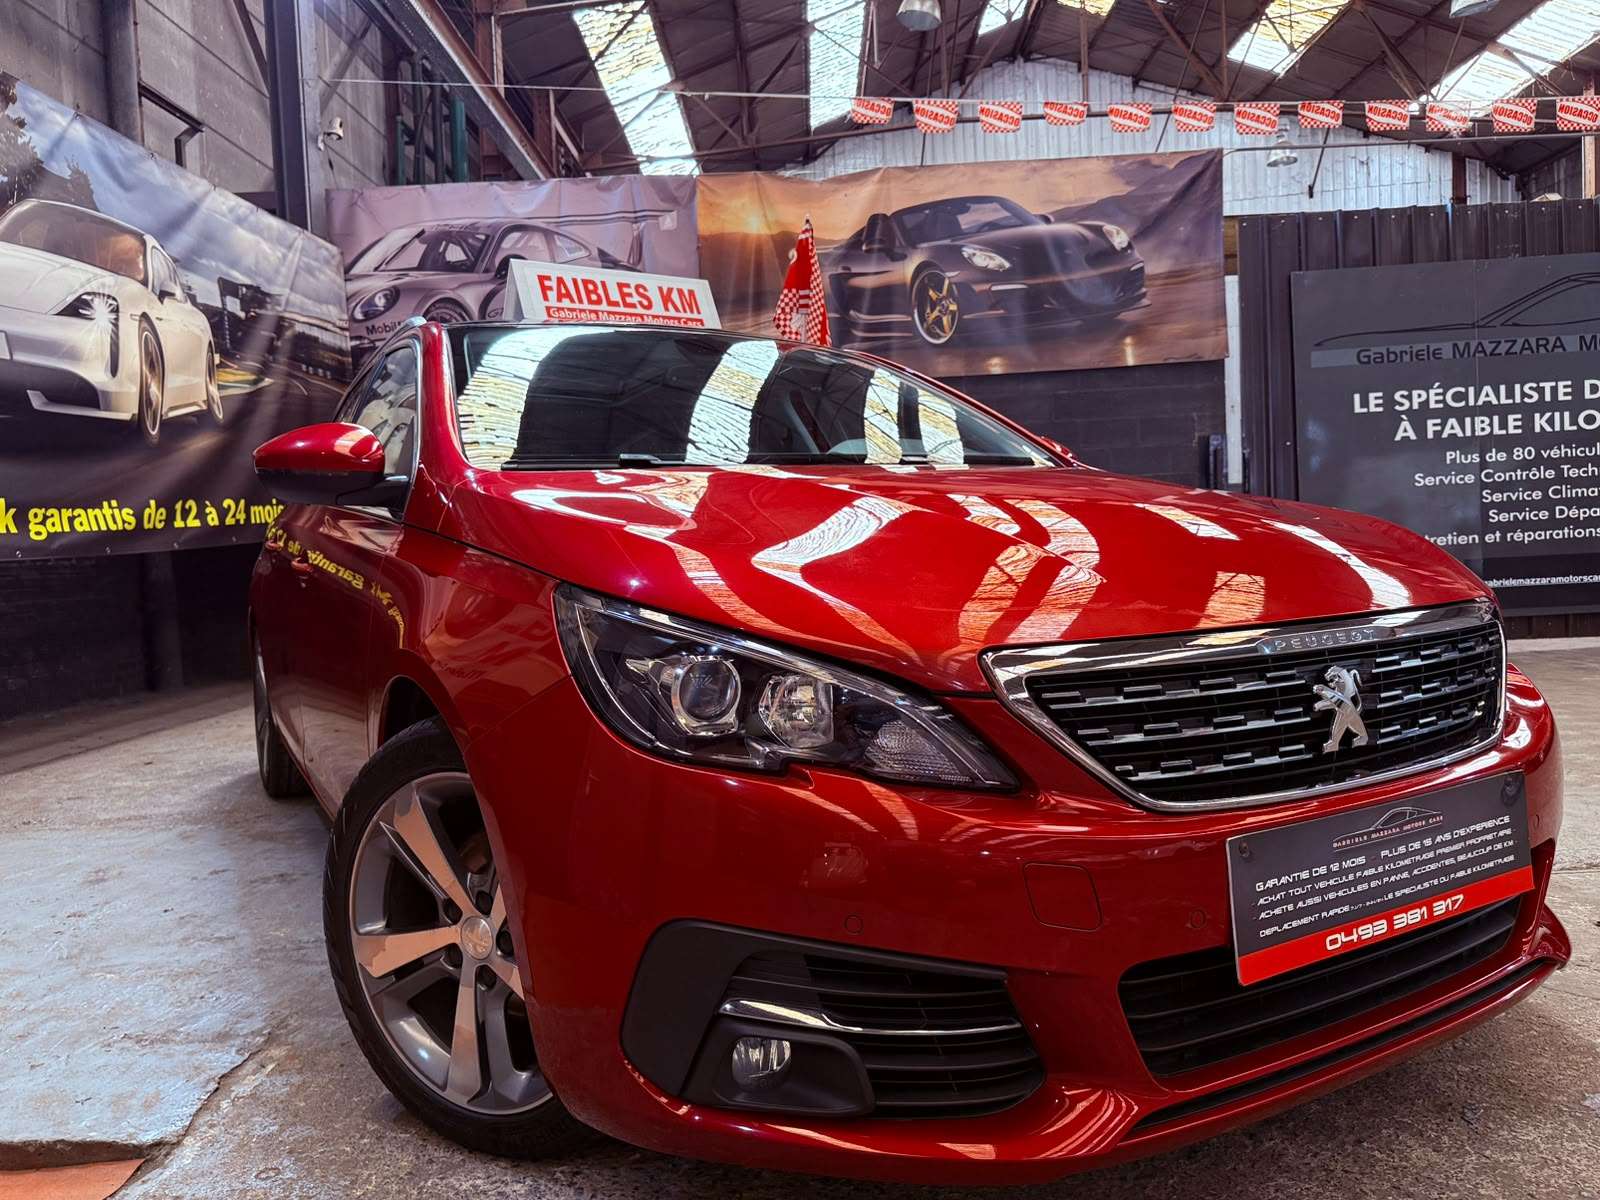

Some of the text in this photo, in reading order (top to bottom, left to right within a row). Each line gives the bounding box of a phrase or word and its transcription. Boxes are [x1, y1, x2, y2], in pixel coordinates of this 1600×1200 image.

[536, 274, 702, 315] FAIBLES KM
[550, 308, 597, 321] Gabriele
[598, 311, 642, 323] Mazzara
[1355, 334, 1600, 365] Gabriele MAZZARA M
[1353, 391, 1384, 413] LE
[1393, 380, 1573, 412] SPÉCIALISTE
[1394, 415, 1417, 441] À
[1425, 413, 1523, 439] FAIBLE
[1445, 450, 1480, 464] Plus
[1485, 448, 1508, 462] de
[1512, 446, 1536, 460] 80
[1413, 472, 1475, 487] Service
[1480, 465, 1556, 483] Contrôle
[1481, 488, 1543, 503] Service
[28, 499, 137, 541] garantis
[143, 499, 167, 529] de
[174, 499, 201, 528] 12
[205, 500, 219, 526] à
[222, 498, 246, 525] 24
[1488, 507, 1549, 523] Service
[1484, 530, 1501, 543] et
[1274, 629, 1375, 651] PEUGEOT
[1381, 845, 1407, 859] PLUS
[1408, 841, 1421, 852] DE
[1423, 838, 1433, 847] 15
[1434, 832, 1453, 844] ANS
[1255, 855, 1366, 892] GARANTIE DE 12 MOIS
[1257, 891, 1286, 906] ACHAT
[1288, 884, 1313, 896] TOUT
[1314, 873, 1355, 890] VEHICULE
[1385, 849, 1435, 871] KILOMETRAGE
[1436, 841, 1465, 856] PREMIER
[1259, 903, 1294, 920] ACHETE
[1296, 896, 1322, 909] AUSSI
[1323, 882, 1369, 901] VEHICULES
[1370, 878, 1382, 888] EN
[1457, 845, 1492, 862] BEAUCOUP
[1493, 842, 1503, 851] DE
[1503, 839, 1514, 848] KM
[1383, 891, 1394, 900] LE
[1394, 878, 1439, 898] SPECIALISTE
[1440, 875, 1450, 884] DU
[1259, 913, 1320, 938] DEPLACEMENT
[1321, 904, 1350, 919] RAPIDE
[1325, 893, 1464, 951] 0493 381 317
